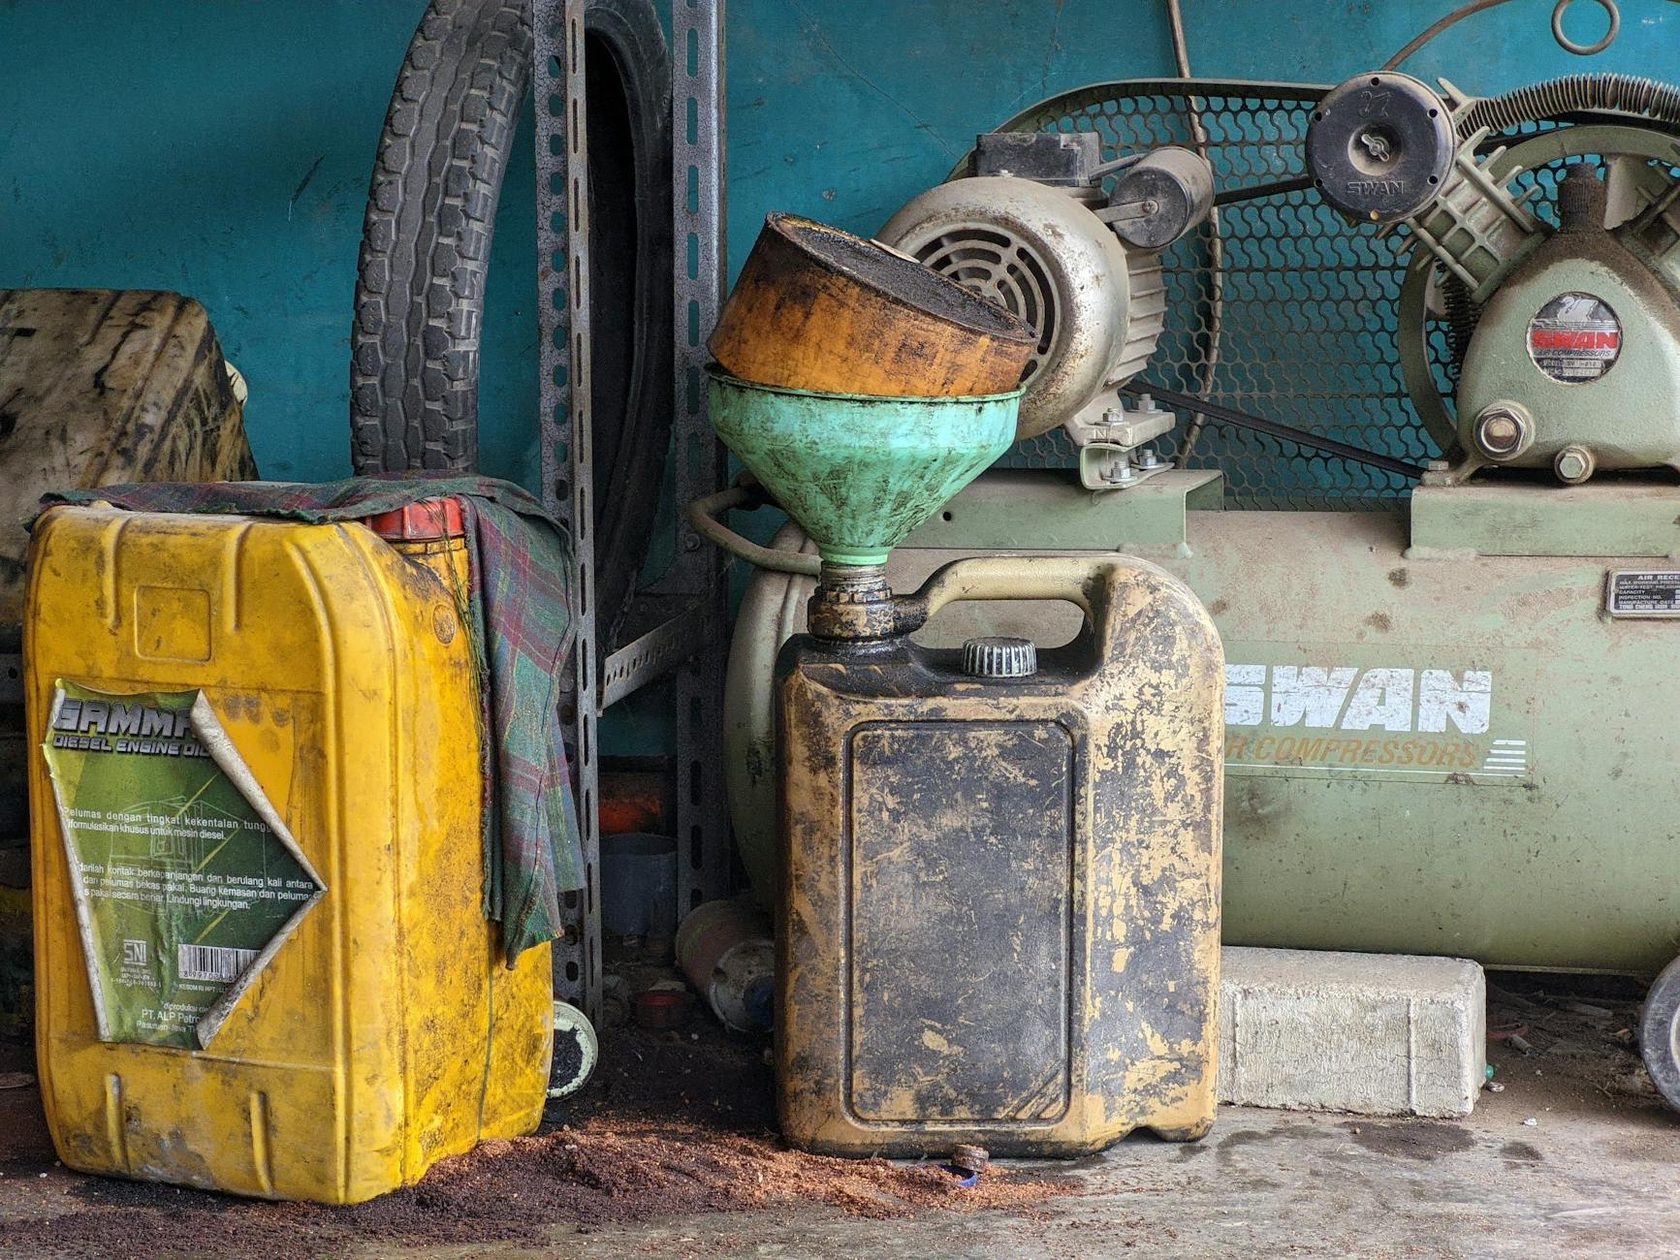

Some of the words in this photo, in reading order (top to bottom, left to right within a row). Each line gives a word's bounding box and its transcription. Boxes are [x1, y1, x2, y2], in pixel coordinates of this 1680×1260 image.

[1348, 181, 1404, 195] SWAN
[1533, 331, 1618, 349] SWAN
[1224, 664, 1492, 734] SWAN
[53, 733, 112, 752] DIESEL
[116, 738, 180, 757] ENGINE
[183, 743, 211, 758] OIL
[1254, 735, 1476, 768] COMPRESSORS
[63, 806, 102, 819] Pelumas
[106, 811, 142, 824] dengan
[146, 814, 180, 826] tingkat
[185, 816, 239, 828] kekentalan
[243, 820, 272, 833] tungg
[120, 823, 150, 834] khusus
[150, 826, 172, 836] untuk
[173, 828, 198, 838] mesin
[200, 830, 226, 840] diesel.
[100, 878, 134, 888] pelumas
[136, 880, 160, 890] bekas
[190, 884, 216, 896] Buang
[218, 886, 257, 898] kemasan
[258, 889, 276, 898] dan
[108, 865, 135, 877] kontak
[137, 867, 204, 882] berkepanjangan
[206, 872, 223, 883] dan
[226, 874, 264, 888] berulang
[268, 876, 282, 888] kali
[286, 879, 313, 890] antara
[112, 891, 140, 900] secara
[202, 896, 250, 910] lingkungan.
[124, 941, 147, 963] SNI
[142, 1008, 156, 1020] PT.
[156, 1010, 176, 1021] ALP
